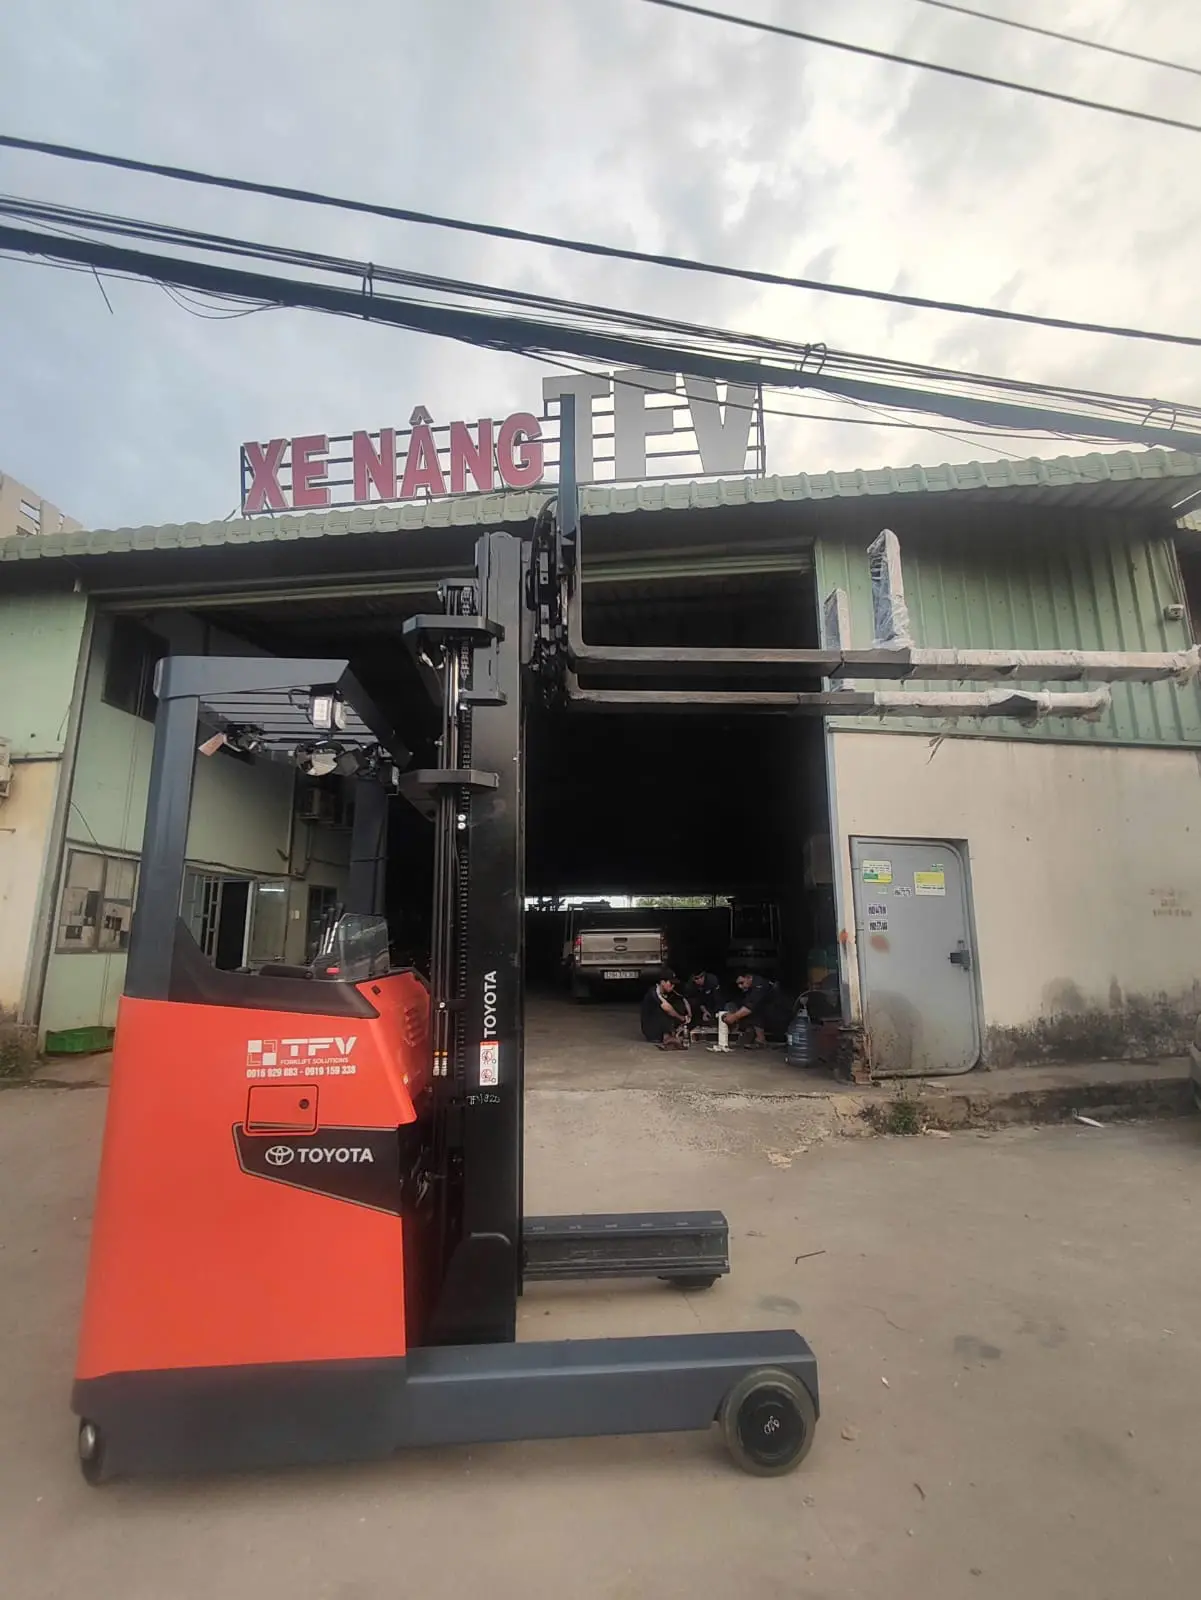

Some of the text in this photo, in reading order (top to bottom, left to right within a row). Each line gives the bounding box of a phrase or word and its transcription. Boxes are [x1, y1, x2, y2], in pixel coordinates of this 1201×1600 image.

[242, 369, 759, 512] XE NÂNG TFV
[484, 970, 497, 1039] TOYOTA
[281, 1036, 357, 1057] TFV
[297, 1147, 374, 1163] TOYOTA
